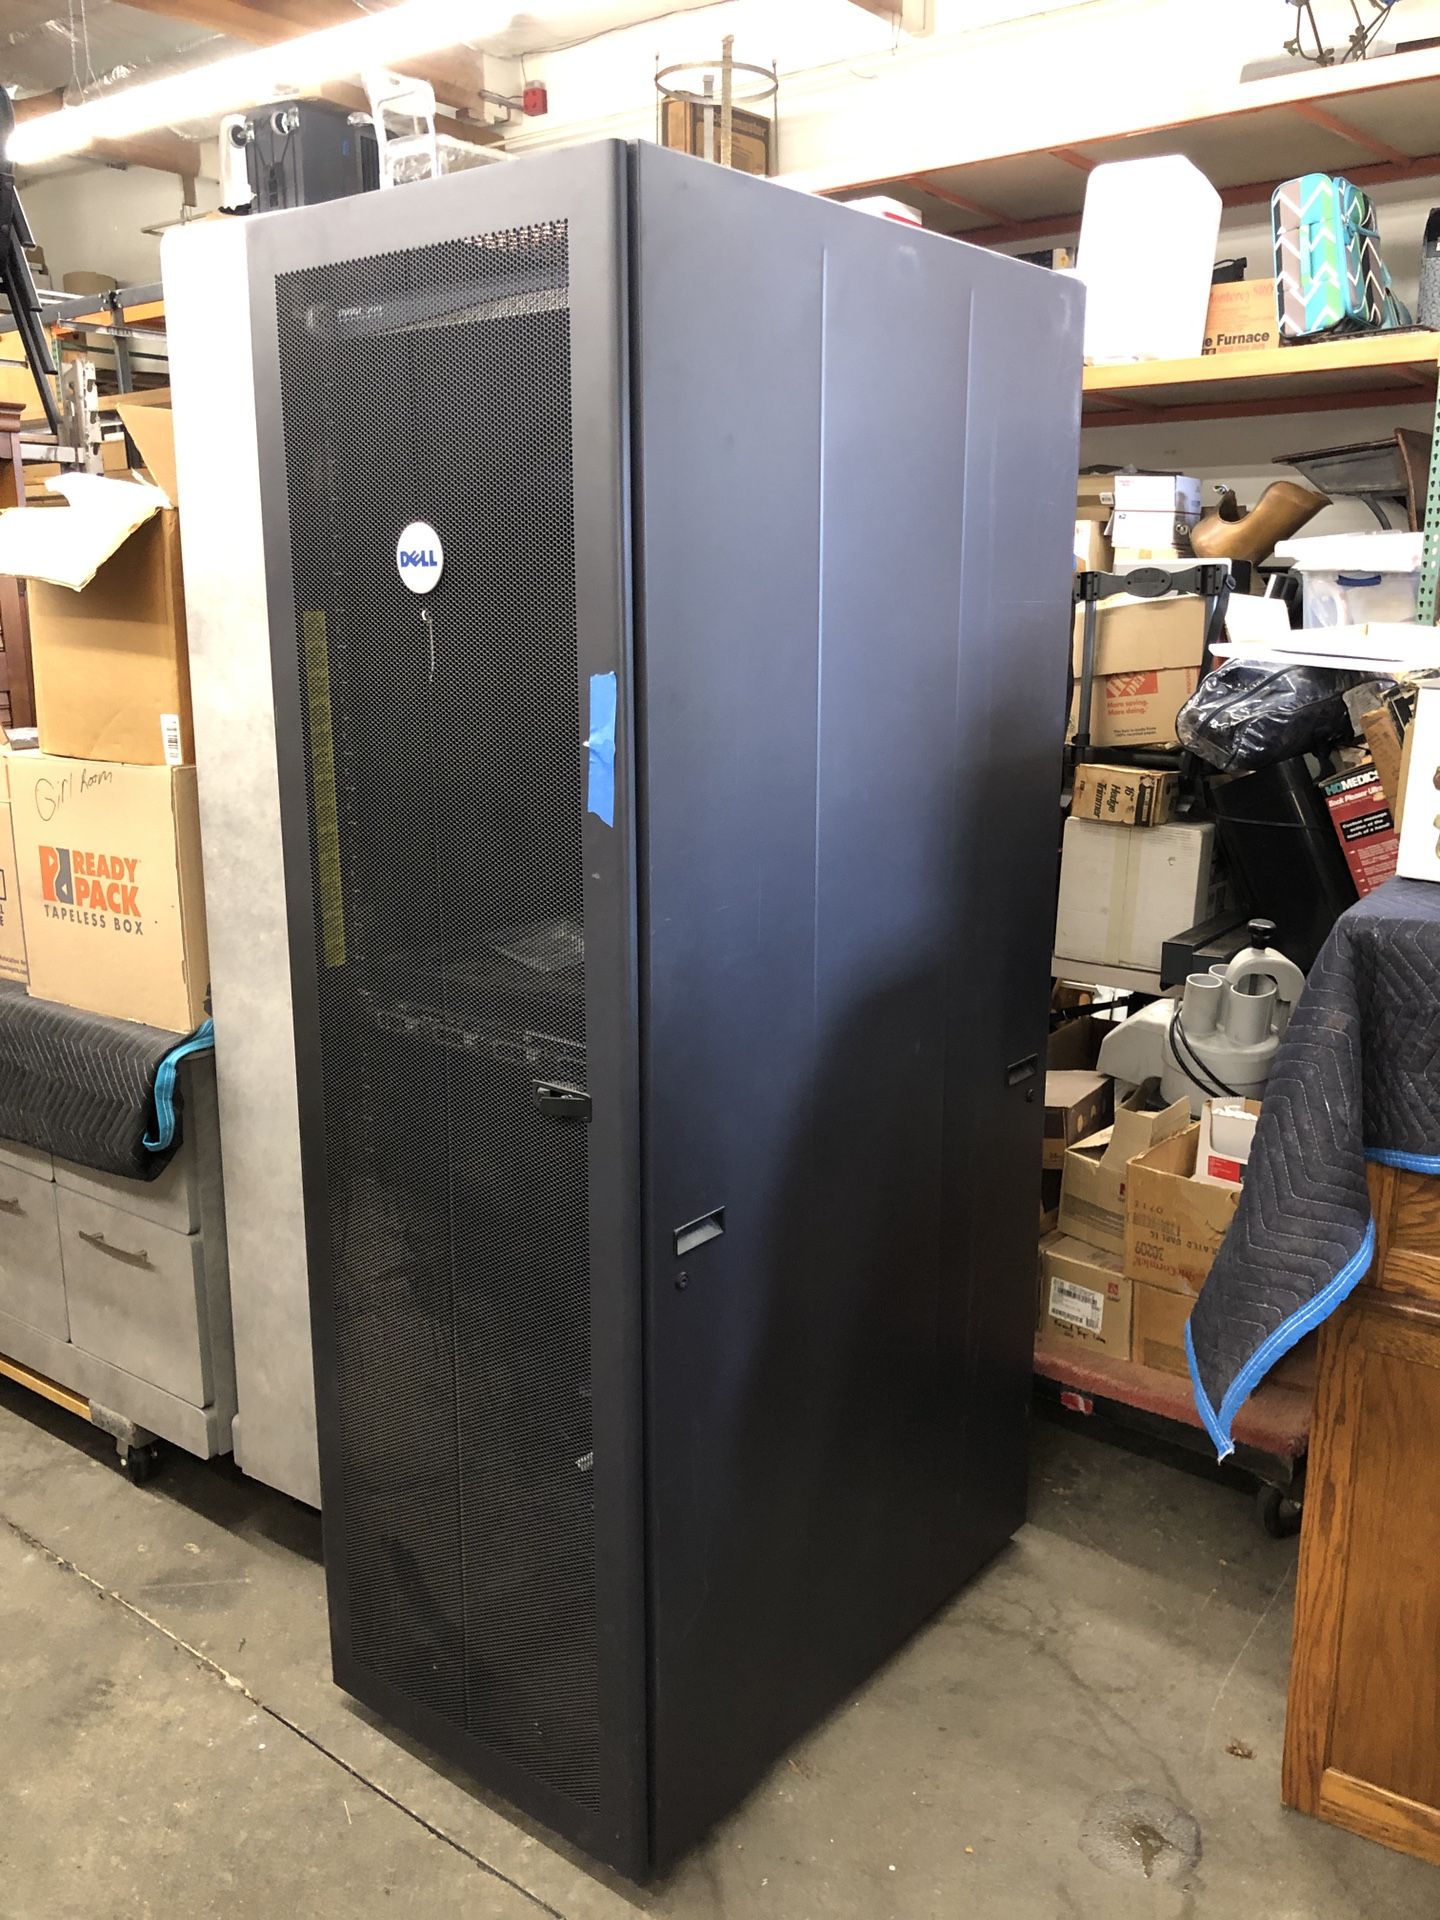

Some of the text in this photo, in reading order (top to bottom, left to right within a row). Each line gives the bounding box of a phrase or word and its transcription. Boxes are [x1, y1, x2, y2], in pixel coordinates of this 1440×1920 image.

[1217, 332, 1270, 346] Furnace
[400, 550, 437, 567] DELL
[35, 772, 73, 821] Girl
[1093, 782, 1107, 819] Trimmer
[1107, 784, 1121, 813] Hedge
[72, 850, 138, 883] READY
[74, 876, 142, 918] PACK
[44, 904, 144, 936] TAPELESS BOX
